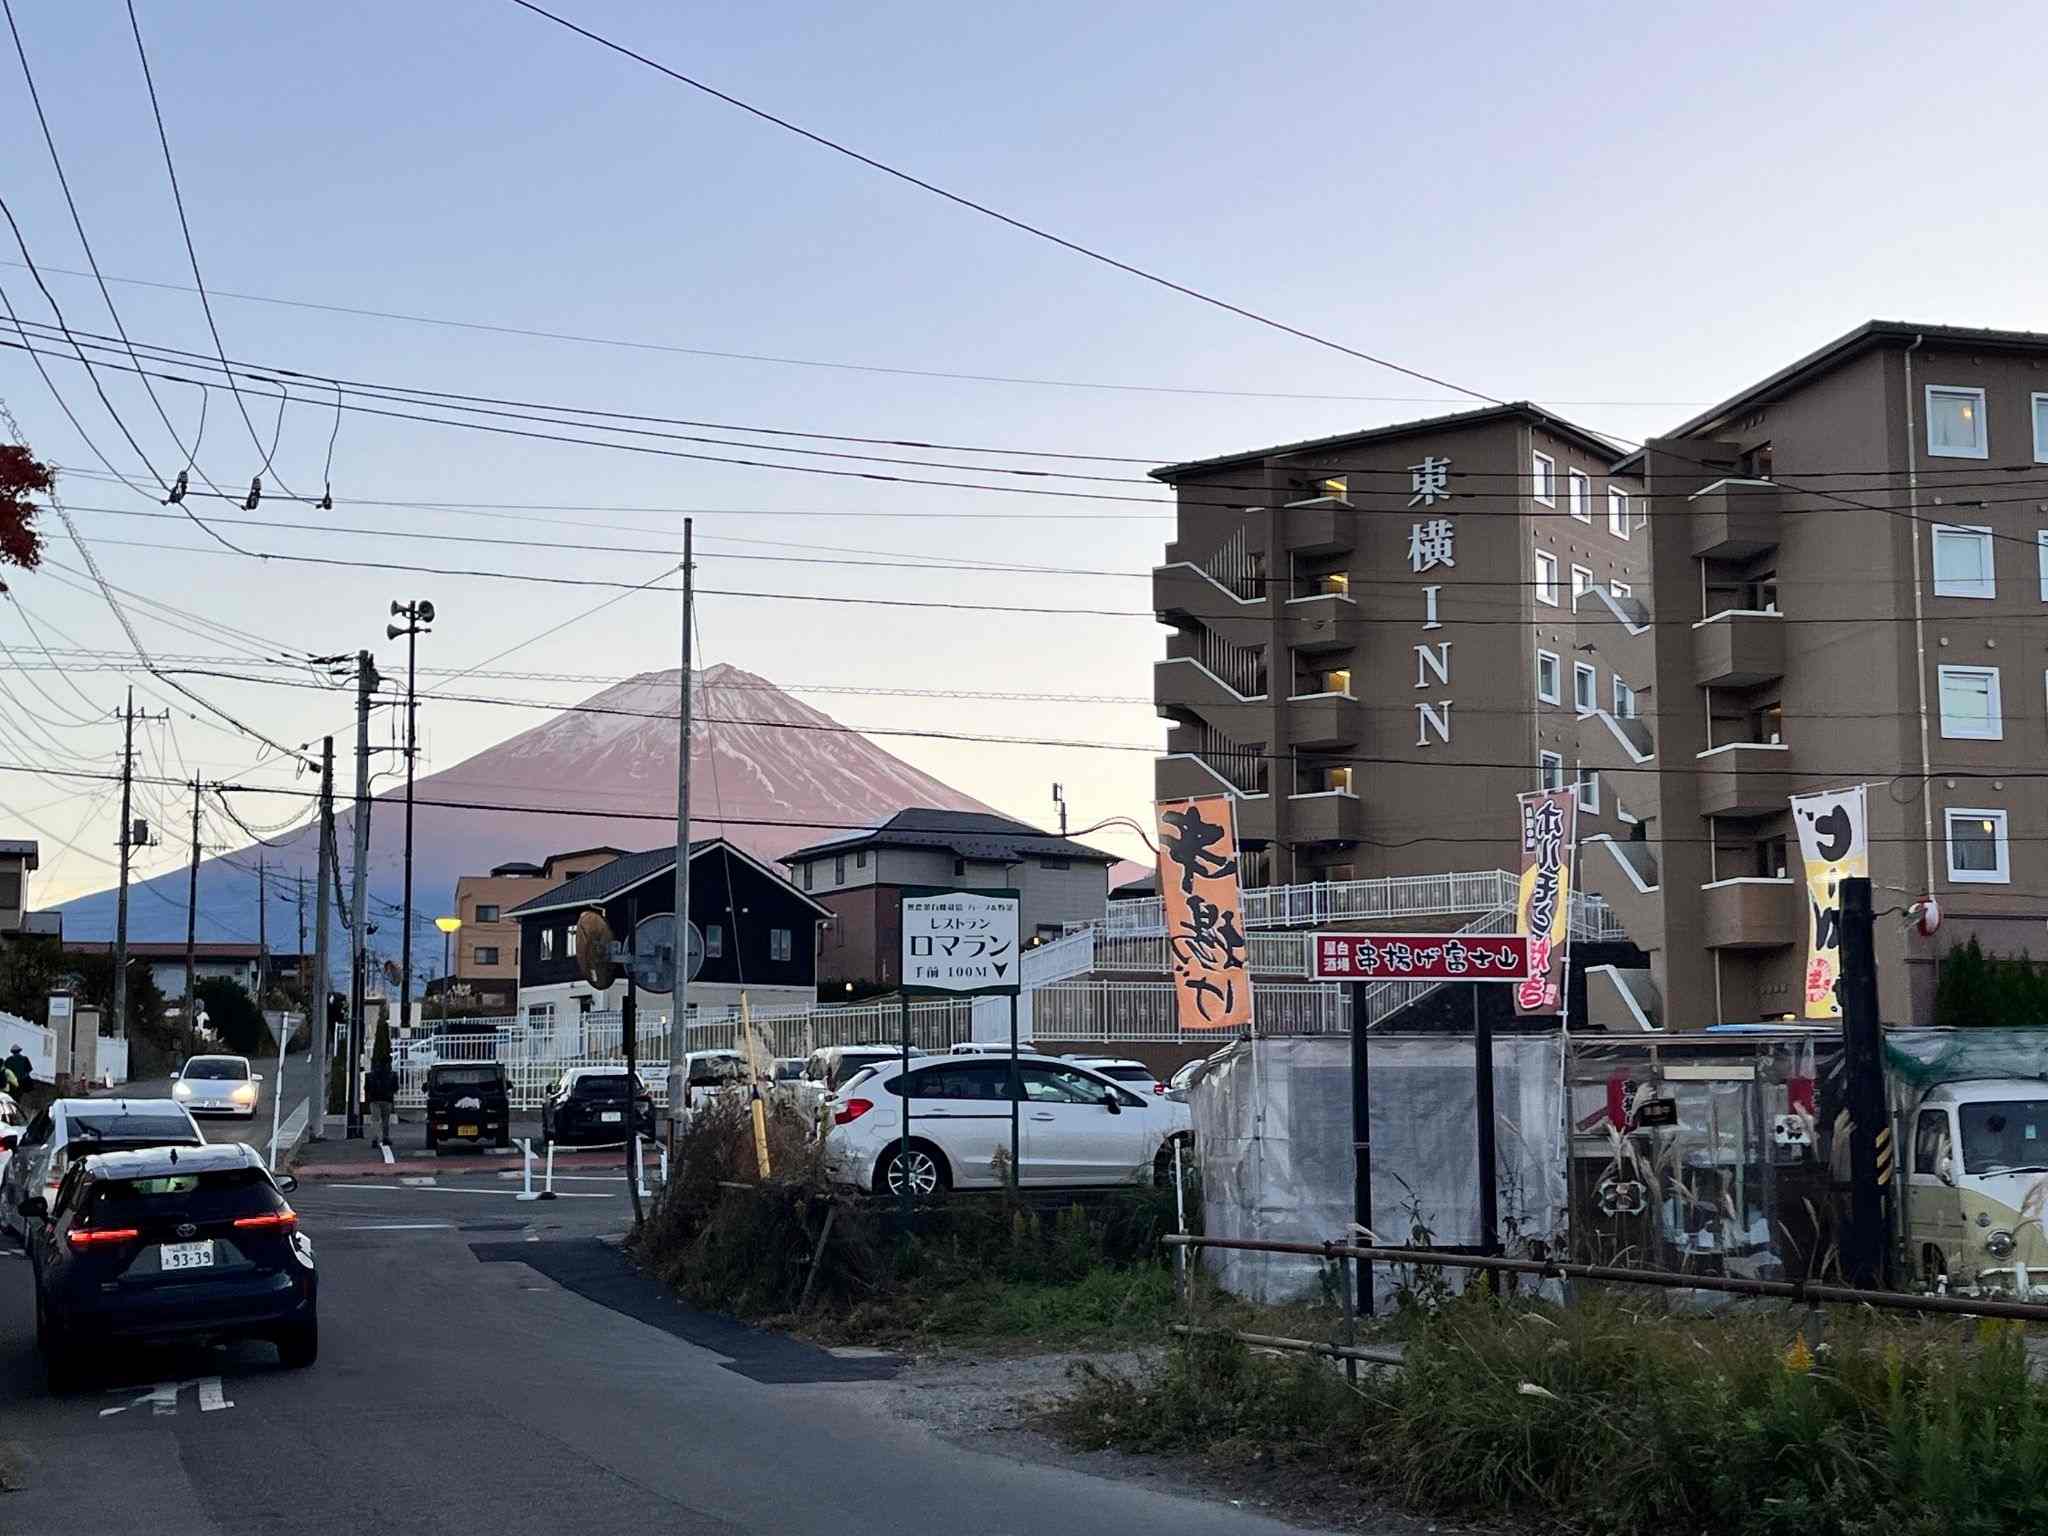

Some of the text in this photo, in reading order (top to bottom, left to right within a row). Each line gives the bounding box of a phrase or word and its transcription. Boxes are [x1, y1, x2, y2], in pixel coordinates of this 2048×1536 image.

[1407, 456, 1456, 747] 東横INN
[931, 918, 991, 930] レストラン
[910, 935, 1013, 958] ロマラン
[1355, 939, 1519, 975] 串揚げ富士山
